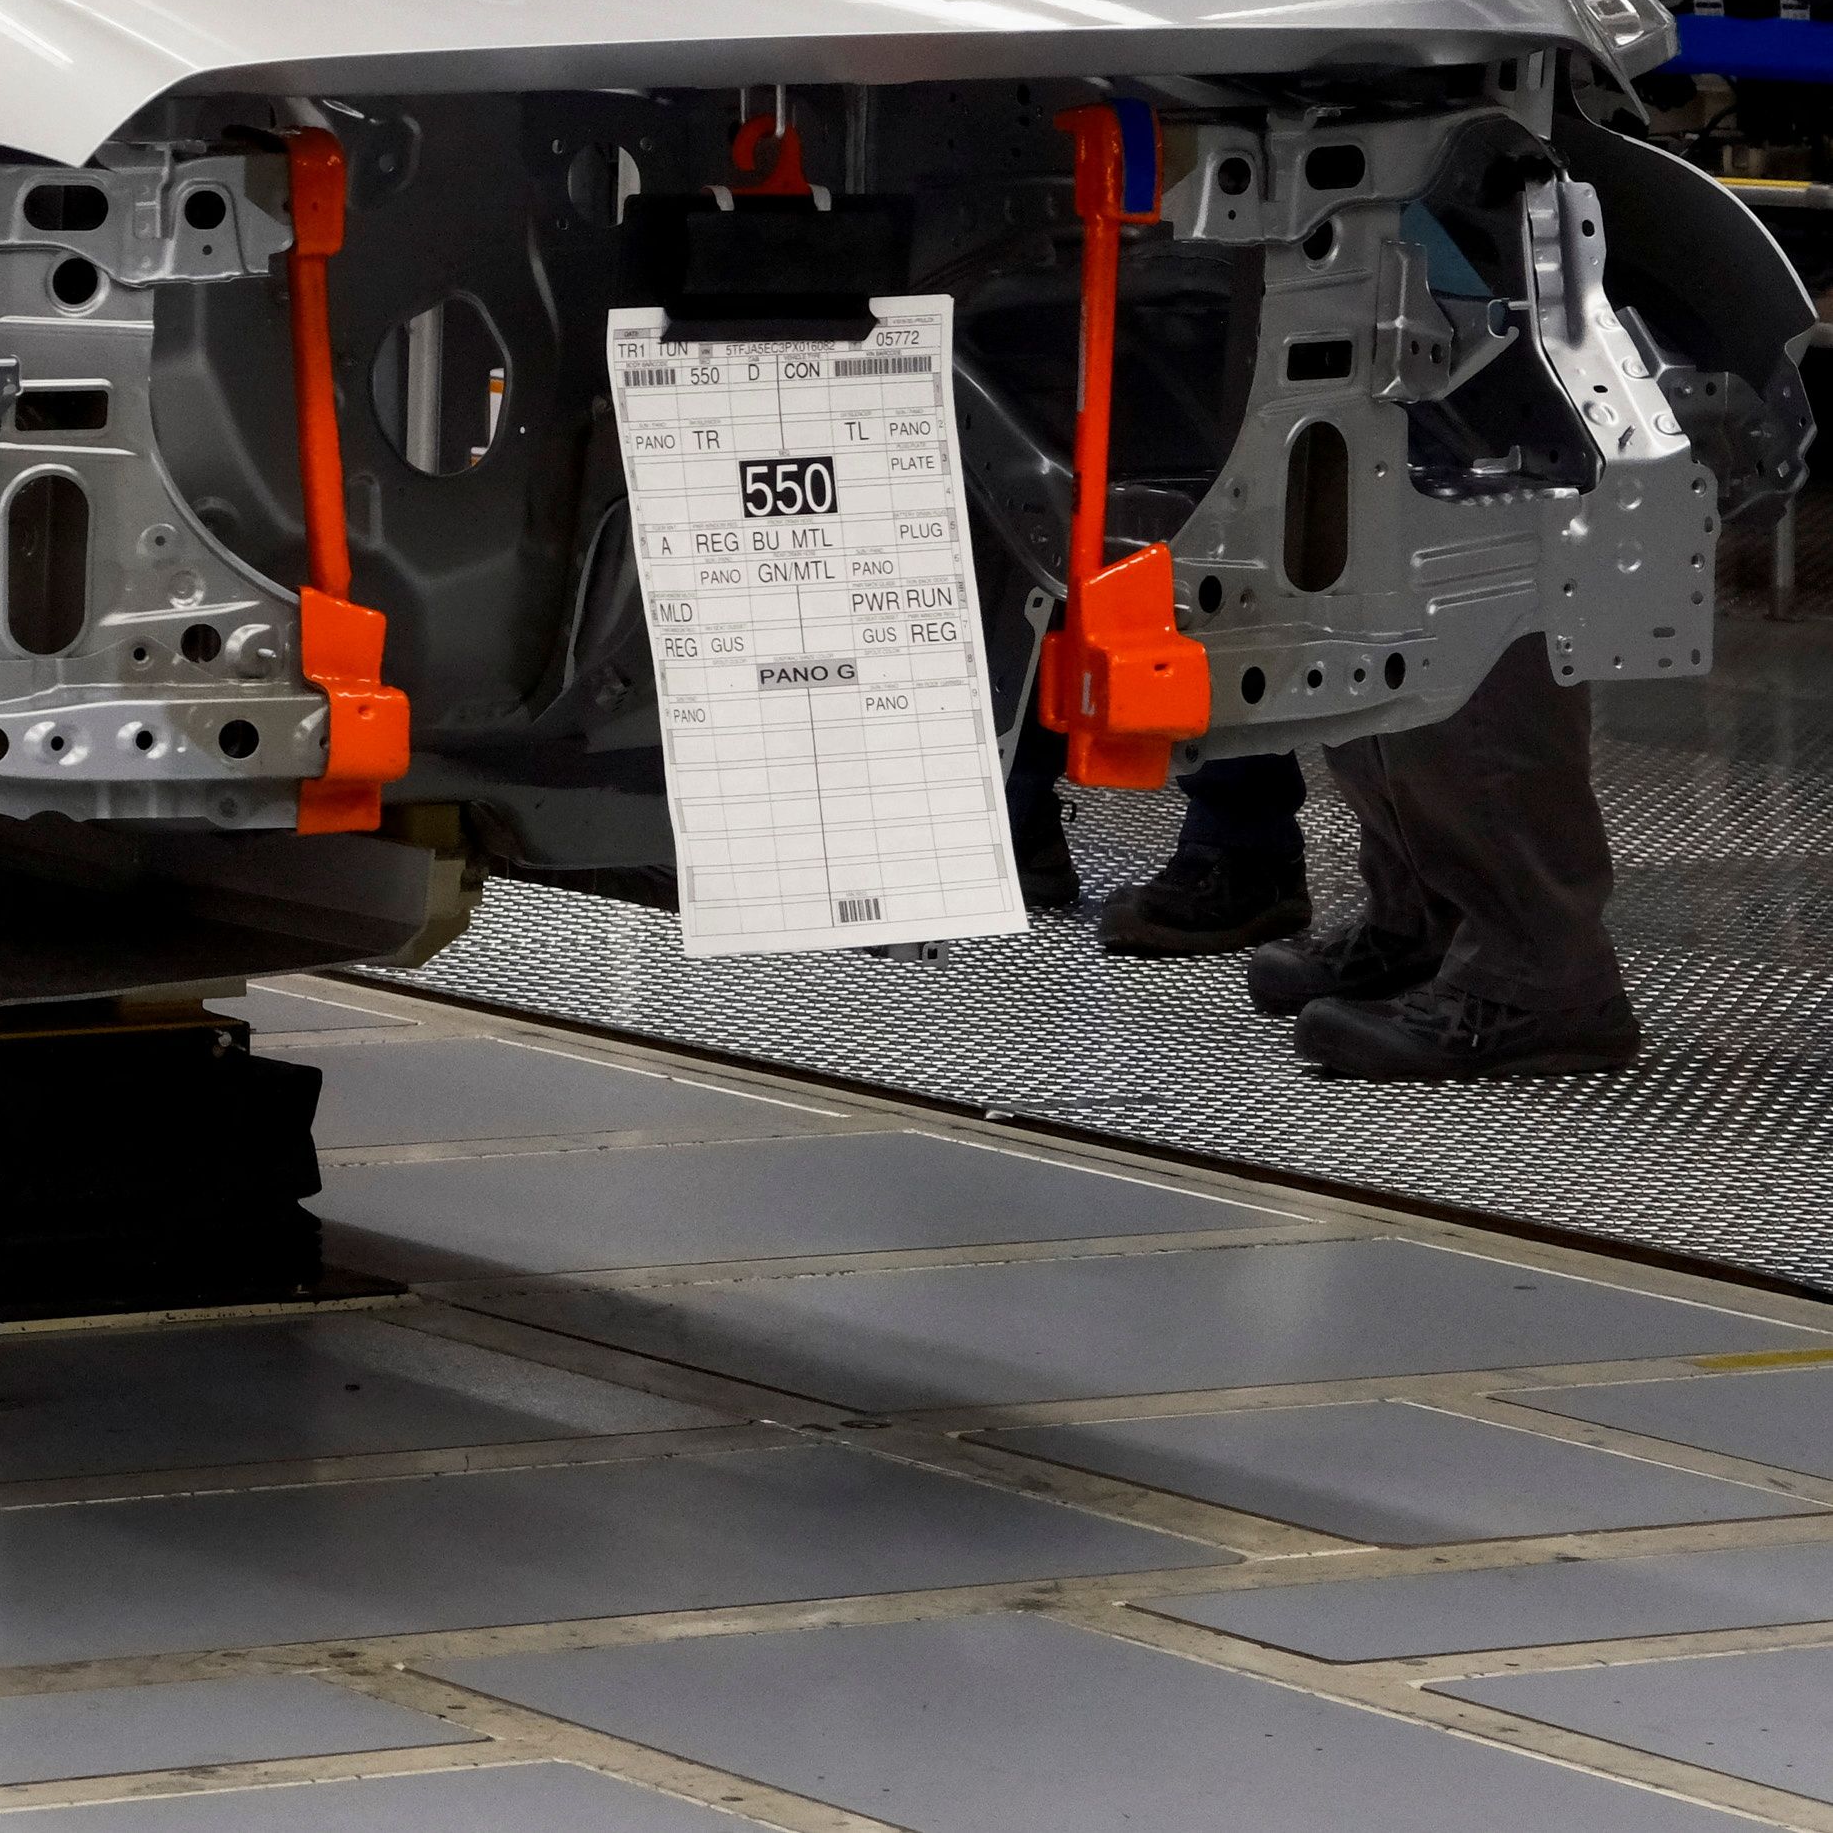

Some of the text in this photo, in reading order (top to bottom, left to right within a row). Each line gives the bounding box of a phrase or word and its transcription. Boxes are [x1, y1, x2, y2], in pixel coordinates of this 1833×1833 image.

[876, 330, 920, 347] 05772
[618, 343, 645, 358] TR1
[658, 341, 688, 357] TUN
[690, 367, 720, 384] 550
[748, 364, 760, 381] D
[784, 362, 820, 378] CON
[844, 422, 869, 440] TL
[890, 421, 931, 436] PANO
[636, 435, 675, 449] PANO
[692, 430, 720, 450] TR
[891, 456, 935, 470] PLATE
[746, 463, 832, 516] 550
[900, 522, 943, 539] PLUG
[661, 536, 672, 555] A
[696, 532, 740, 553] REG
[753, 528, 833, 551] BU MTL
[700, 569, 741, 584] PANO
[758, 560, 835, 583] GN/MTL
[852, 560, 894, 576] PANO
[852, 591, 900, 612] PWR
[906, 587, 952, 608] RUN
[660, 603, 693, 622] MLD
[863, 627, 897, 643] GUS
[911, 621, 957, 643] REG
[665, 638, 698, 657] REG
[711, 636, 744, 652] GUS
[760, 664, 855, 684] PANO G
[866, 695, 909, 711] PANO
[674, 708, 706, 722] PANO
